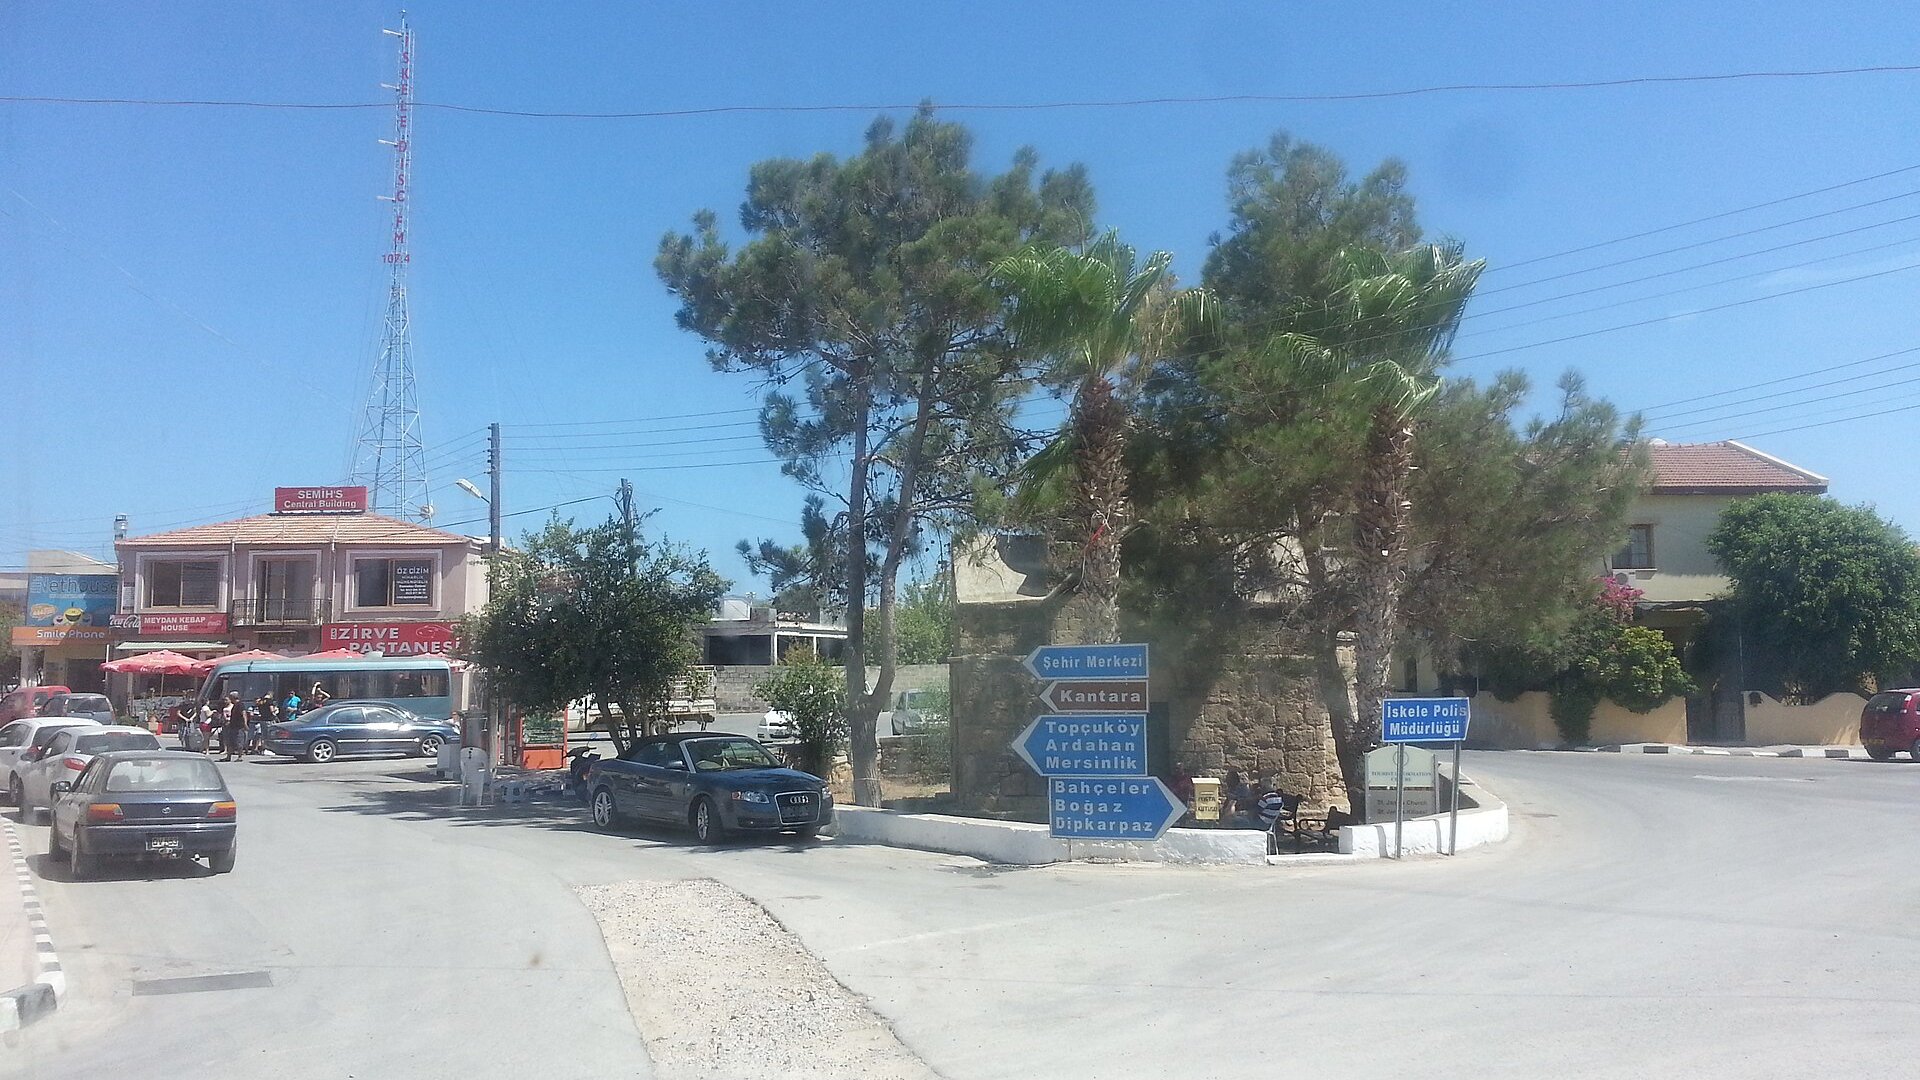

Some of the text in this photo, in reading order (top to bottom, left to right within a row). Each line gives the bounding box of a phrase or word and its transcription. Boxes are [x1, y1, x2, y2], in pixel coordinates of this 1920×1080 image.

[397, 141, 407, 202] DISC
[394, 216, 404, 243] FM
[297, 488, 343, 499] SEMİH'S
[284, 500, 356, 509] Central Building
[144, 616, 177, 624] MEYDAN
[180, 616, 206, 624] KEBAP
[36, 629, 105, 638] Smile Phone
[338, 624, 399, 640] ZİRVE
[1043, 654, 1143, 670] Şehir Merkezi
[1060, 689, 1141, 703] Kantara
[1387, 702, 1467, 718] İskele Polis
[1045, 719, 1140, 736] Topçuköy
[1390, 721, 1460, 737] Müdürlüğü
[1045, 738, 1135, 752] Ardahan
[1046, 755, 1137, 769] Mersinlik
[1055, 781, 1150, 796] Bahçeler
[1055, 799, 1123, 814] Boğaz
[1056, 817, 1153, 834] Dipkarpaz
